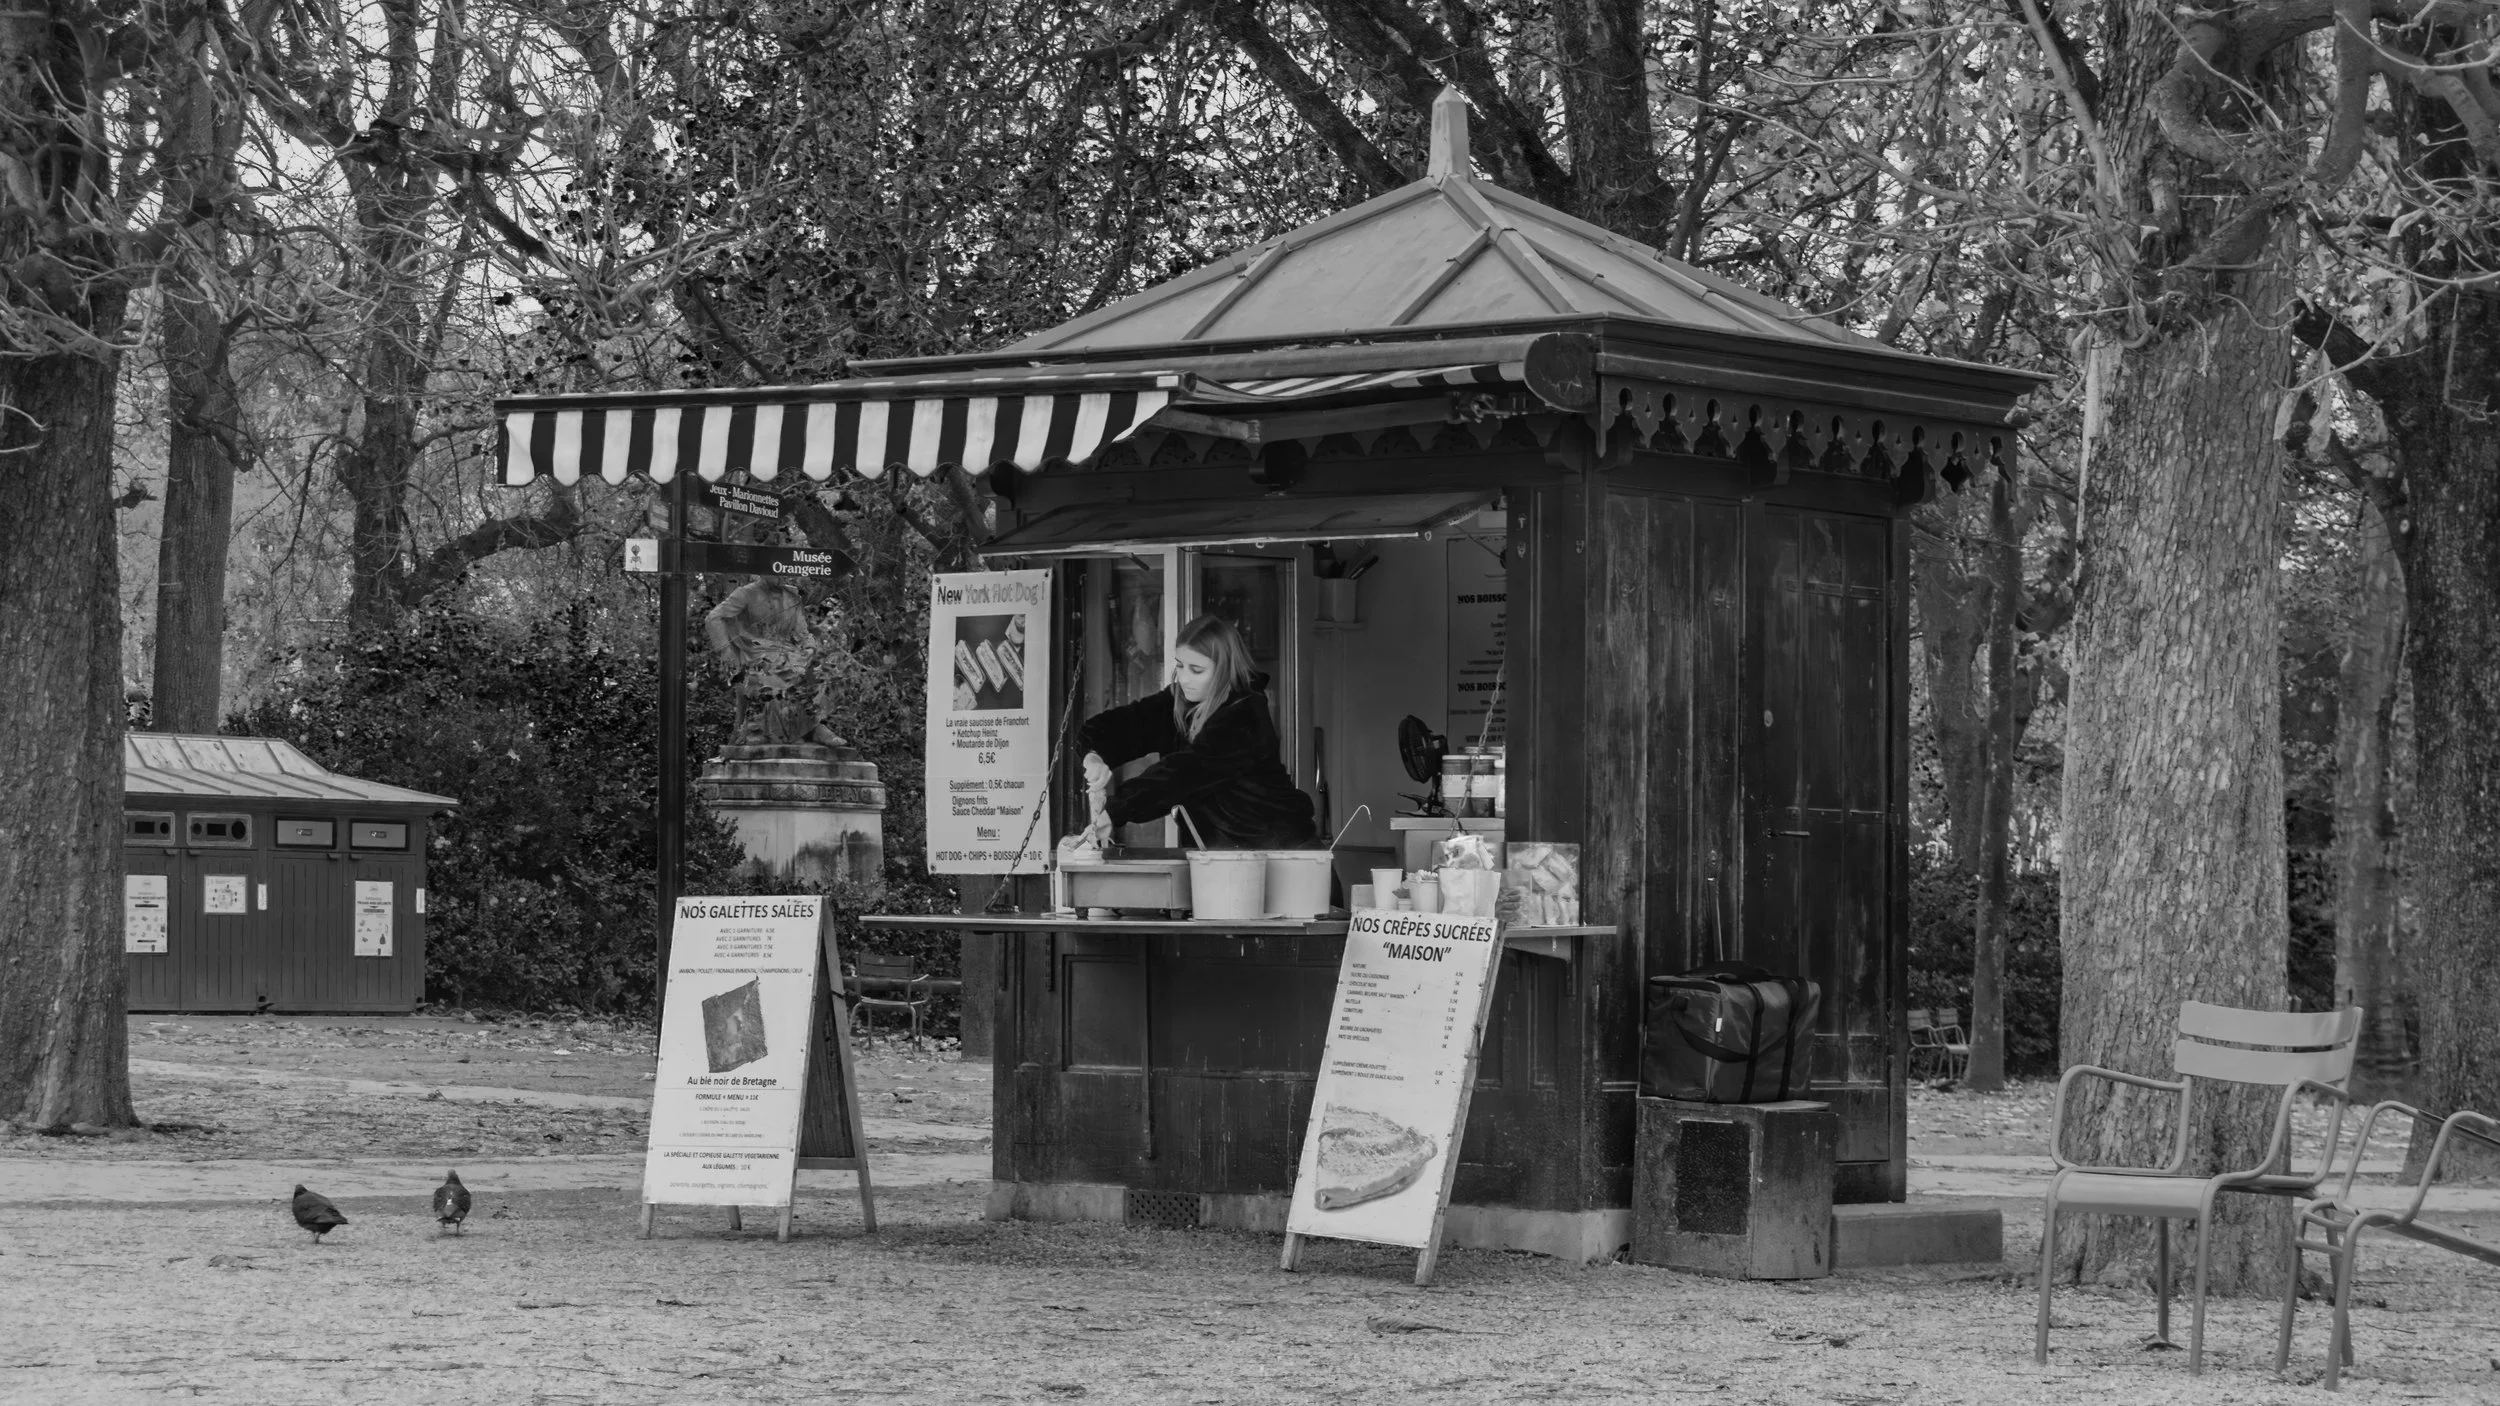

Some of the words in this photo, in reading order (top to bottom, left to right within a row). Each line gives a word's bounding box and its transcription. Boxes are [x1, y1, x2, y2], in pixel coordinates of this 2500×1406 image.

[710, 484, 727, 495] Jeux
[732, 486, 779, 506] Marionnettes
[720, 496, 748, 512] Pavillon
[750, 502, 779, 518] Davioud
[792, 550, 832, 563] Musée
[772, 562, 832, 576] Orangerie
[937, 586, 962, 605] New
[964, 584, 990, 604] York
[992, 584, 1012, 603] Hot
[1016, 582, 1038, 606] Dog
[1457, 595, 1475, 604] NOS
[1457, 683, 1475, 692] NOS
[946, 718, 953, 728] La
[954, 718, 968, 727] vraie
[969, 718, 994, 727] saucisse
[995, 717, 1002, 726] de
[1003, 716, 1029, 726] Francfort
[957, 729, 981, 738] Ketchup
[982, 728, 998, 737] Heinz
[956, 739, 985, 748] Moutarde
[986, 739, 993, 748] de
[994, 738, 1009, 749] Dijon
[950, 780, 984, 791] Supplément
[1004, 780, 1024, 789] chacun
[952, 796, 976, 807] Oignons
[977, 795, 988, 805] frits
[952, 806, 970, 816] Sauce
[972, 806, 995, 815] Cheddar
[977, 827, 996, 838] Menu
[936, 851, 948, 860] HOT
[949, 851, 962, 860] DOG
[969, 851, 987, 860] CHIPS
[1030, 851, 1036, 860] 10
[680, 906, 706, 918] NOS
[710, 905, 768, 918] GALETTES
[1351, 917, 1381, 933] NOS
[1383, 916, 1431, 937] CRÊPES
[1433, 922, 1492, 942] SUCRÉES
[687, 1077, 698, 1085] Au
[714, 1077, 729, 1085] noir
[731, 1077, 740, 1085] de
[742, 1077, 777, 1087] Bretagne
